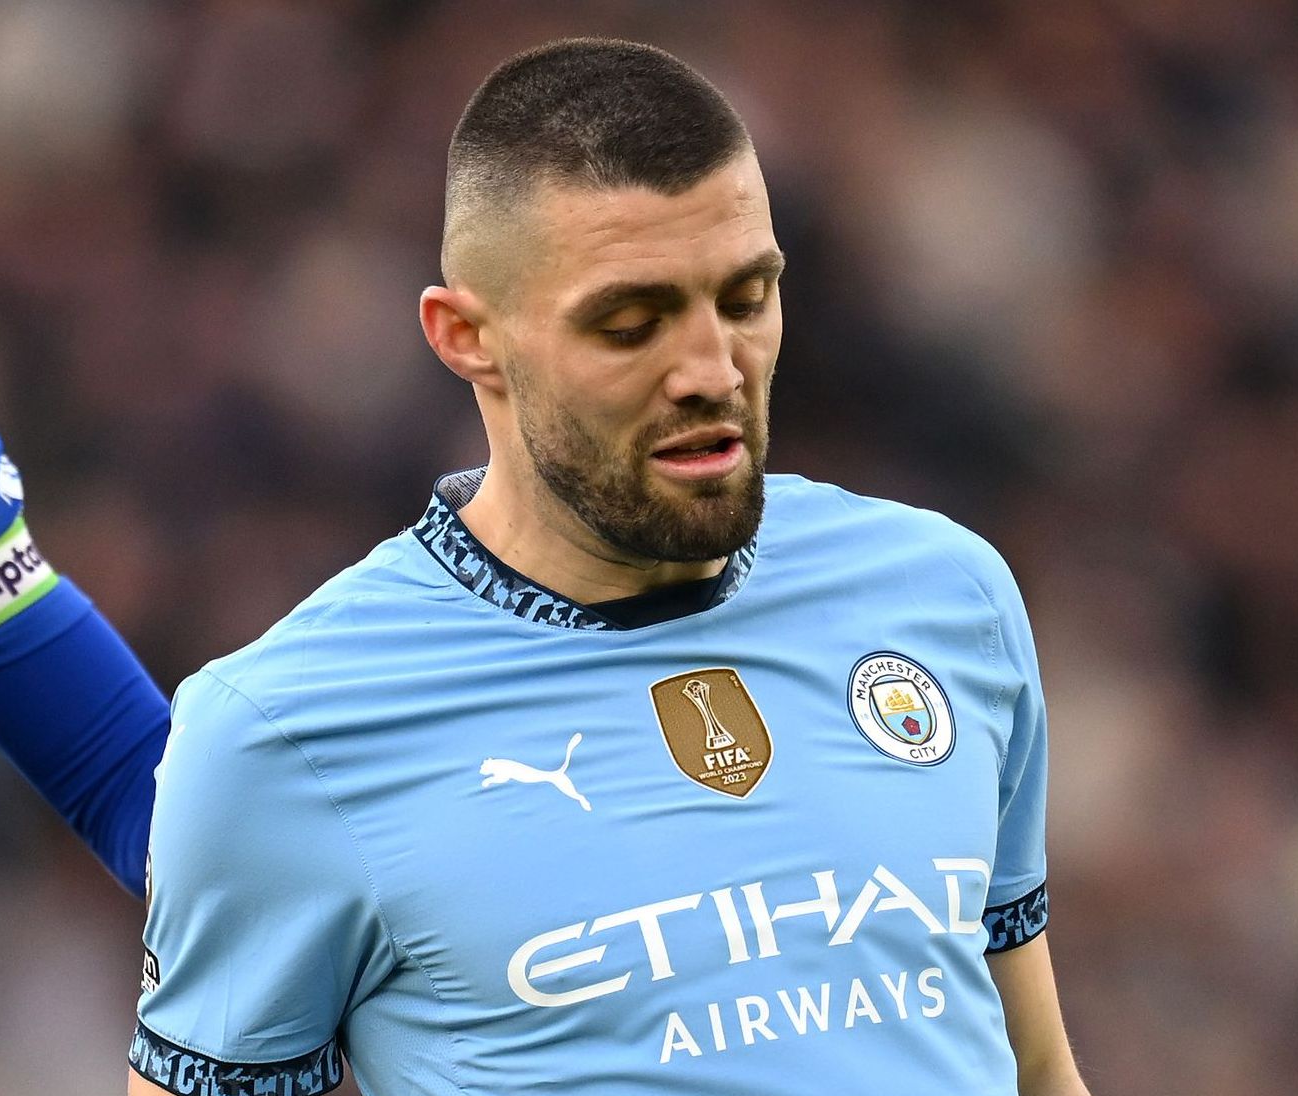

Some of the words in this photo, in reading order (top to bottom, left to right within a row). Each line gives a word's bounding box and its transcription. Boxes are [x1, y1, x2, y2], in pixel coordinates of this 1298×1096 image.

[856, 661, 931, 700] MANCHESTER
[703, 747, 751, 770] FIFA
[909, 745, 937, 759] CITY
[698, 769, 723, 780] WORLD
[722, 772, 747, 785] 2023
[506, 857, 992, 1008] ETIHAD
[659, 967, 947, 1064] AIRWAYS
